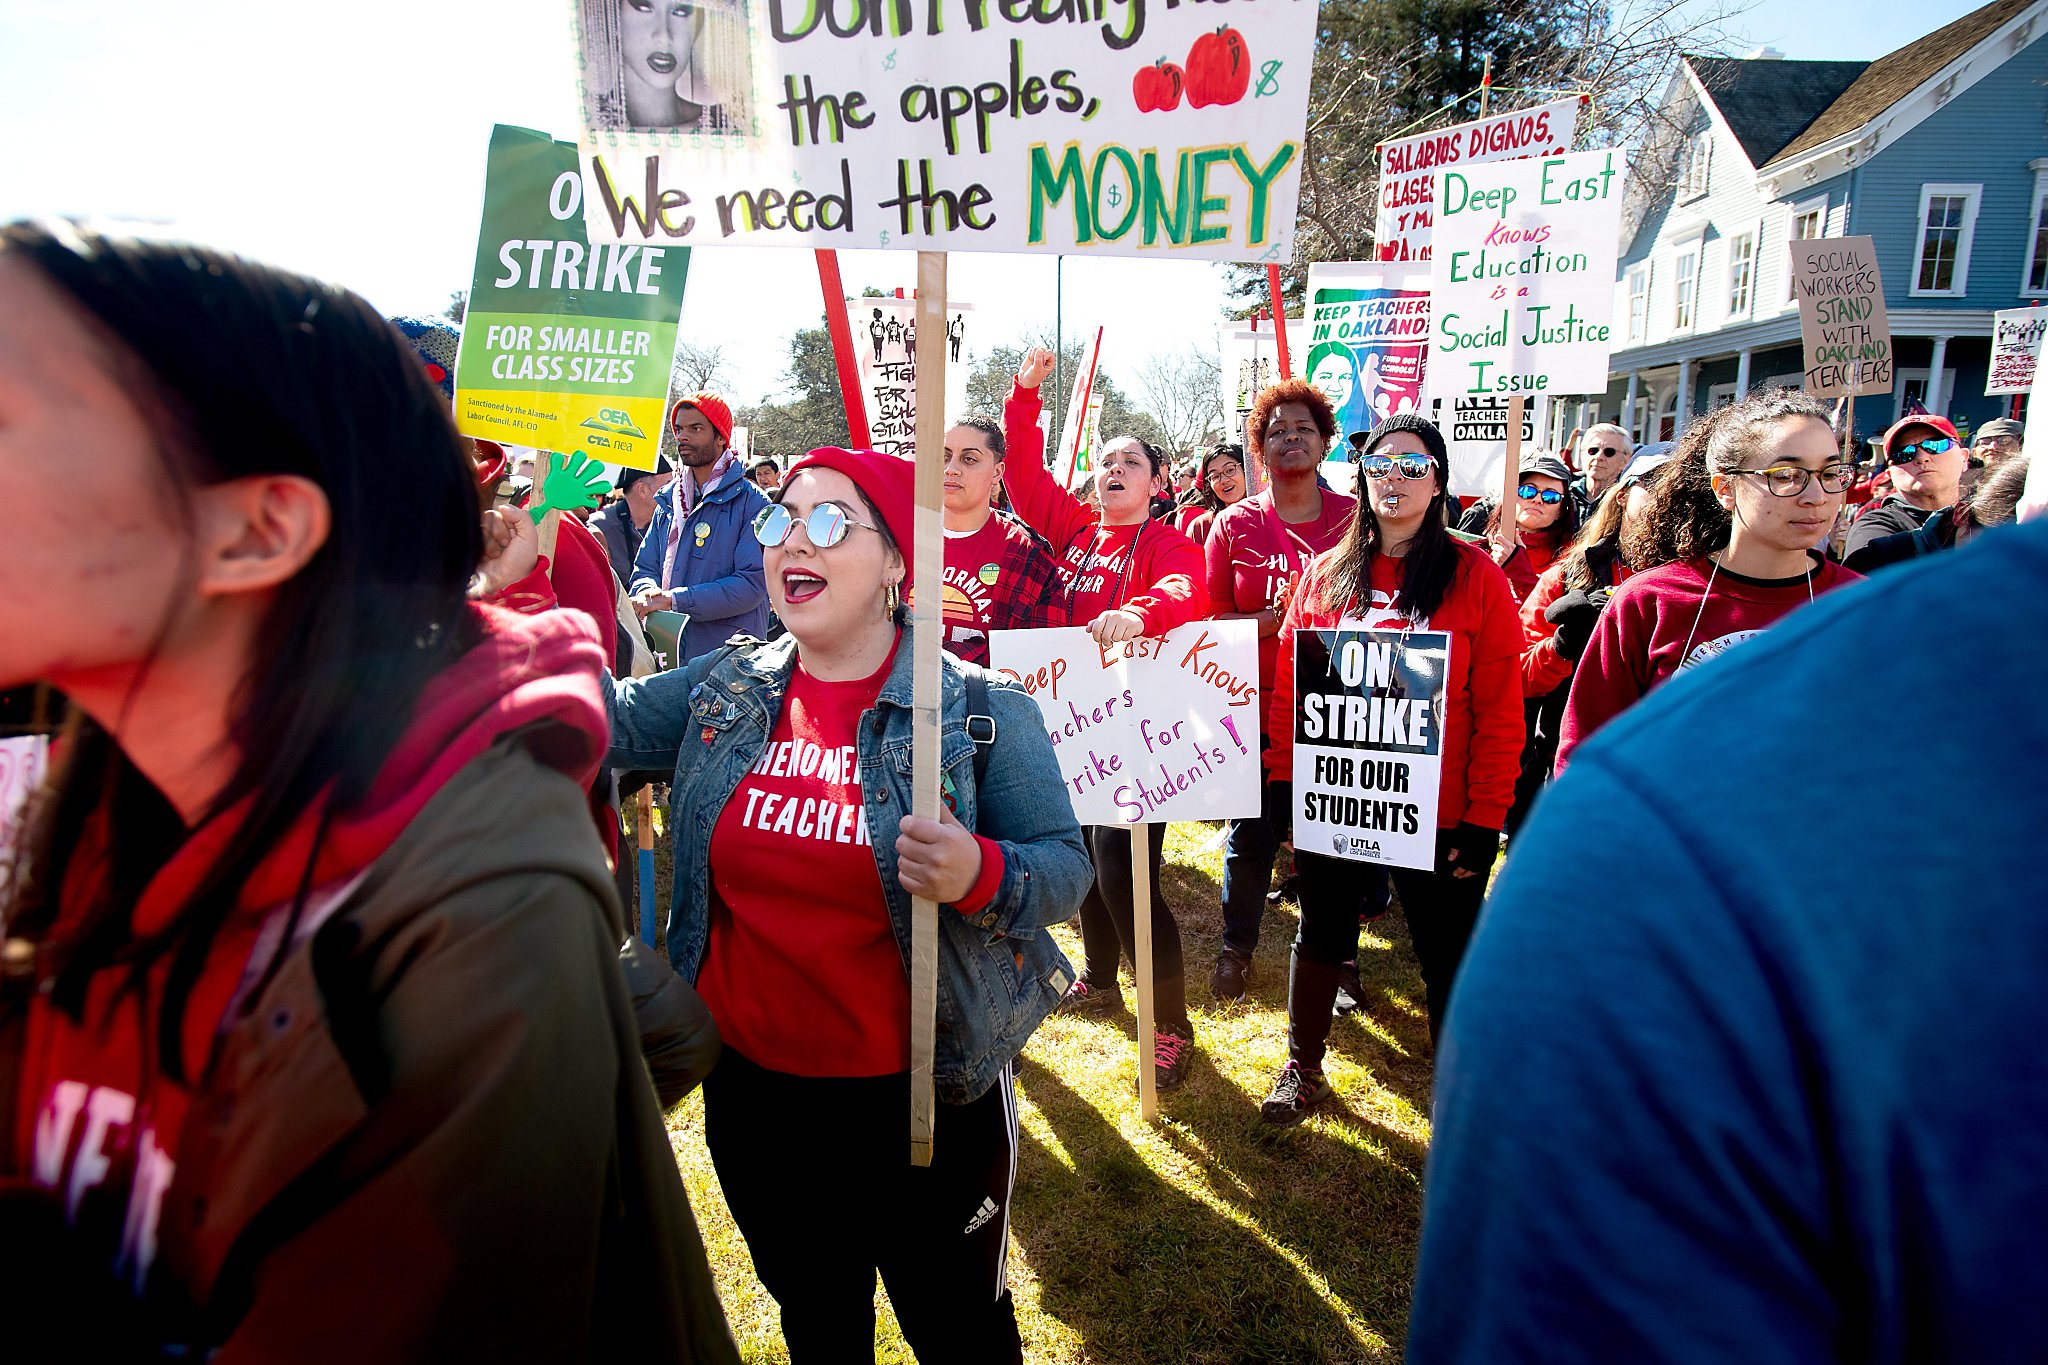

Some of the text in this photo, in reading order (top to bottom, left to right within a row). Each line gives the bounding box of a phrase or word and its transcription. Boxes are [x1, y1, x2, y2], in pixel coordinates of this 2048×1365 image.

[778, 74, 875, 146] the
[901, 38, 1101, 155] apples,
[1386, 111, 1554, 175] SALARIOS DIGNOS,
[549, 171, 587, 221] O
[592, 141, 1301, 249] We need the MONEY
[1444, 152, 1617, 219] Deep East
[1483, 219, 1552, 248] Knows
[494, 239, 666, 296] STRIKE
[1451, 245, 1588, 283] Education
[1806, 251, 1869, 275] SOCIAL
[1489, 285, 1530, 300] is a
[1800, 271, 1877, 298] WORKERS
[1313, 305, 1351, 322] KEEP
[1816, 296, 1873, 325] STAND
[486, 324, 652, 357] FOR SMALLER
[1312, 323, 1332, 341] IN
[1440, 303, 1611, 353] Social Justice
[1822, 325, 1873, 345] WITH
[1815, 340, 1888, 365] OAKLAND
[491, 354, 636, 384] CLASS SIZES
[1467, 361, 1549, 395] Issue
[1805, 358, 1892, 389] TEACHERS
[467, 397, 558, 422] Sanctioned by the Alameda
[874, 386, 906, 406] FOR
[467, 411, 538, 432] Labor Council, AFL-CIO
[598, 407, 634, 427] OEA
[1456, 411, 1507, 421] TEACHER
[587, 434, 633, 452] CTA nea
[1454, 425, 1532, 440] OAKLAD
[1340, 640, 1392, 688] ON
[1694, 638, 1731, 660] TEACH
[1099, 633, 1170, 669] East
[1181, 631, 1258, 707] Knows
[1049, 689, 1134, 747] achers
[1303, 692, 1430, 747] STRIKE
[1066, 718, 1185, 795] rike for
[1314, 754, 1410, 794] FOR OUR
[1304, 791, 1419, 835] STUDENTS
[1350, 837, 1381, 851] UTLA
[964, 1204, 1000, 1234] adidas
